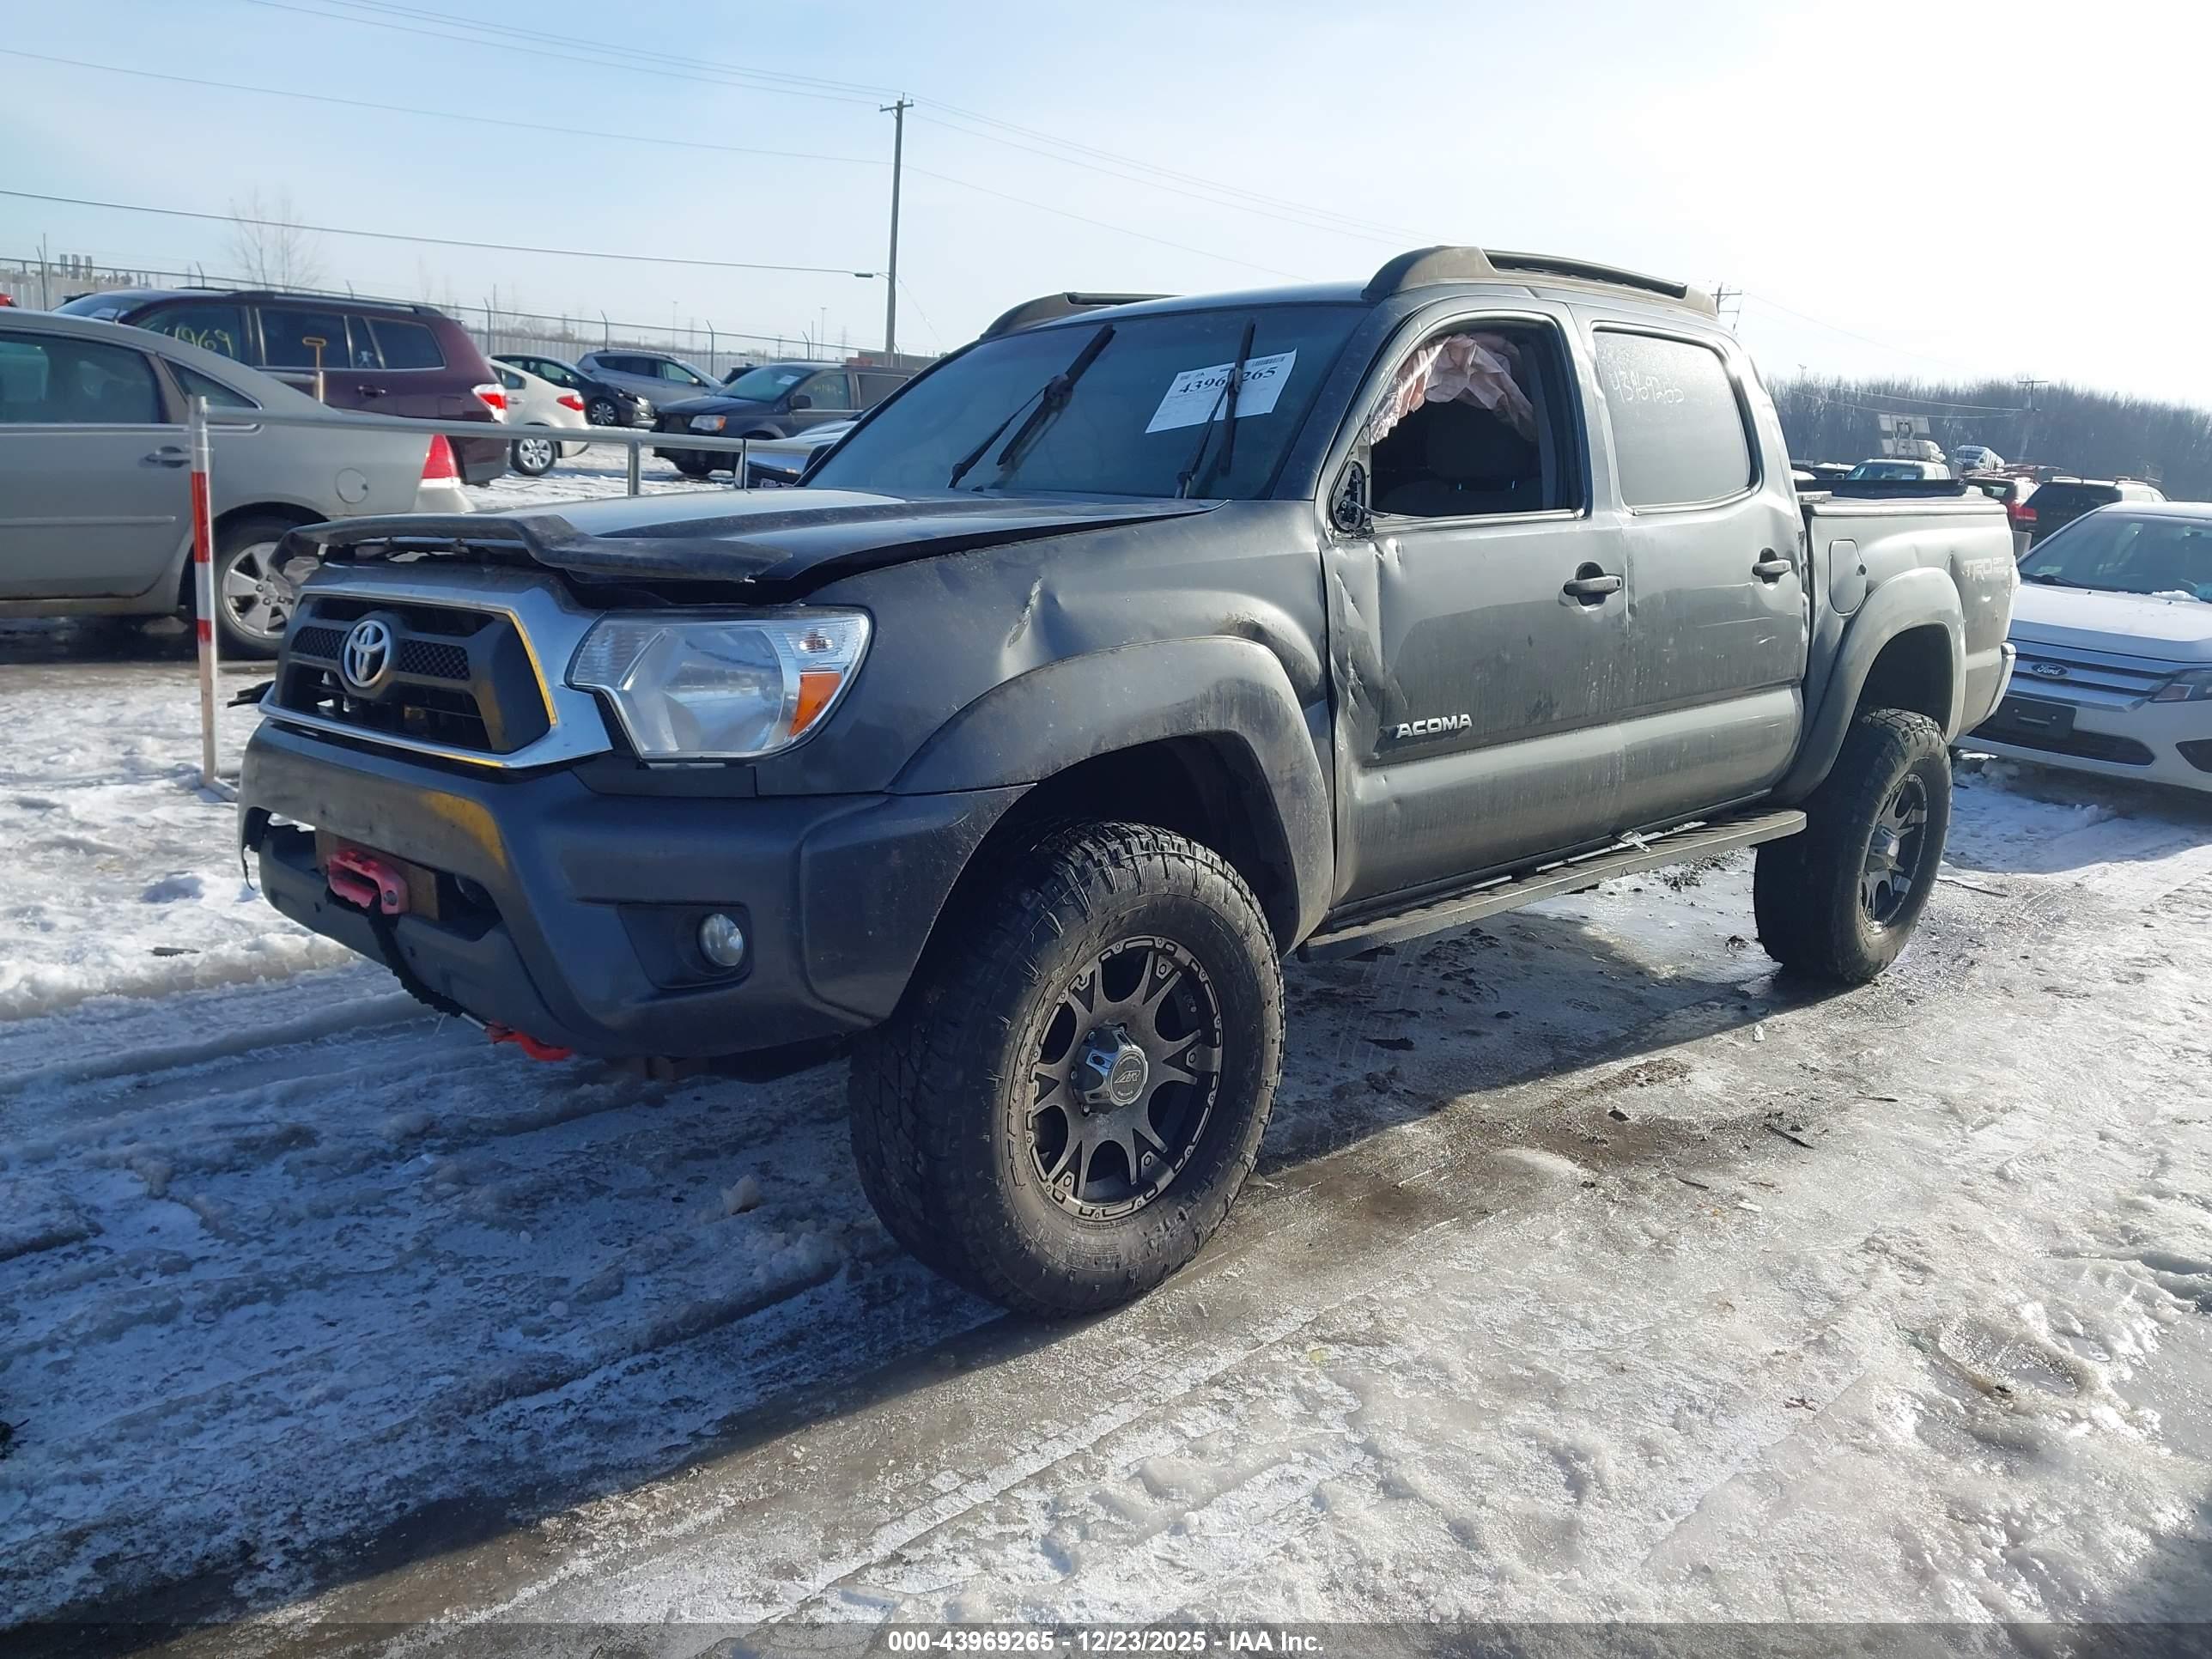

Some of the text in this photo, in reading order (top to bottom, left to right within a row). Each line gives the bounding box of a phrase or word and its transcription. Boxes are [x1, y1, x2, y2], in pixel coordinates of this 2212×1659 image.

[1179, 366, 1279, 393] 4396265
[2037, 665, 2062, 675] Ford
[1396, 714, 1473, 738] ACOMA
